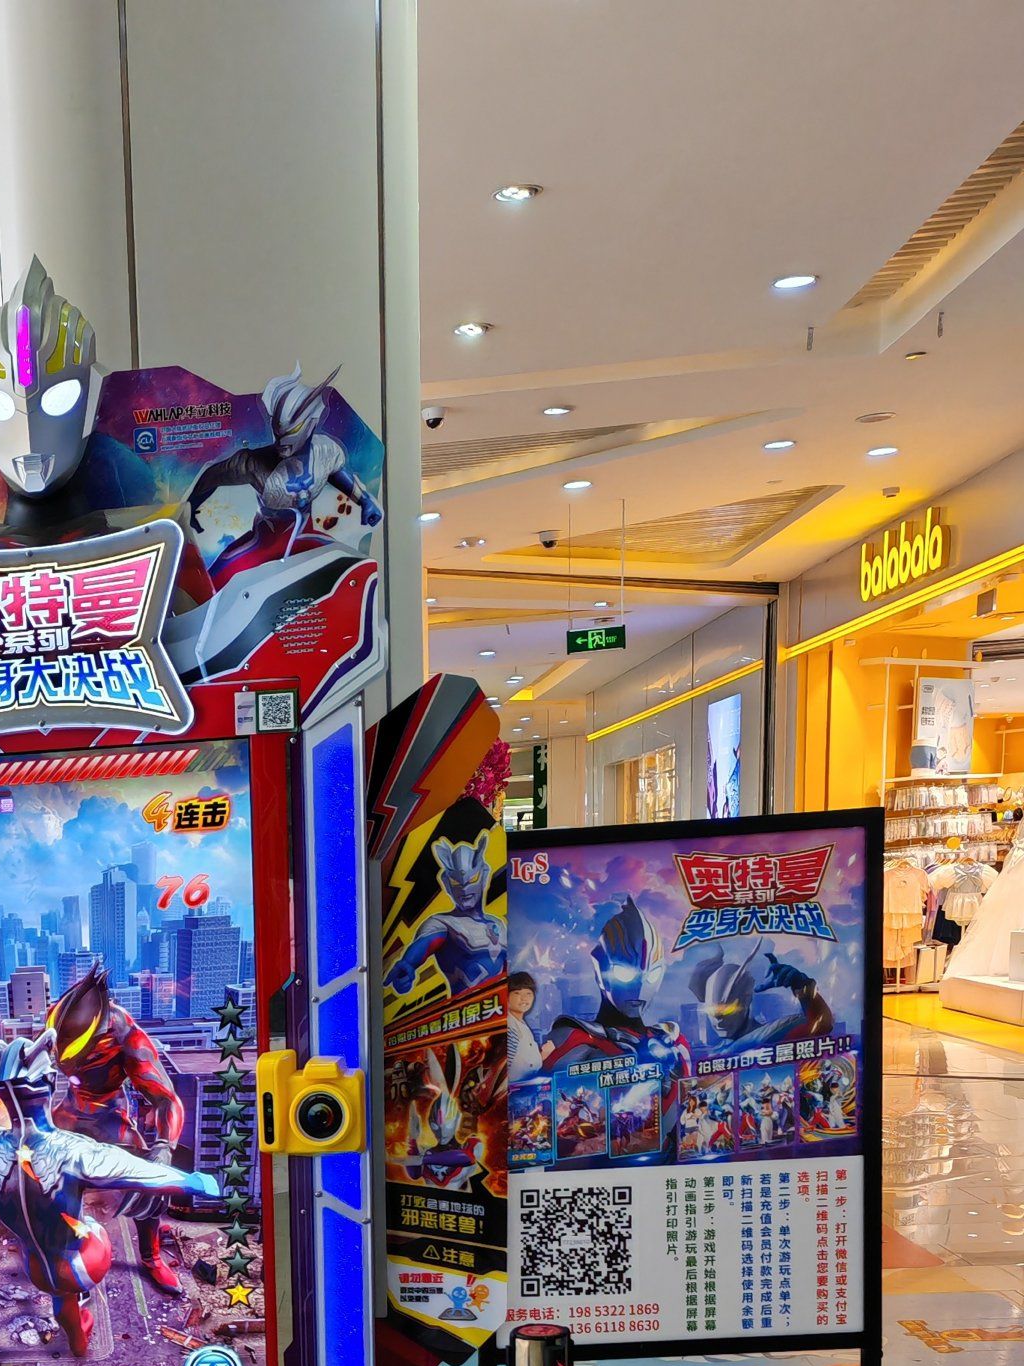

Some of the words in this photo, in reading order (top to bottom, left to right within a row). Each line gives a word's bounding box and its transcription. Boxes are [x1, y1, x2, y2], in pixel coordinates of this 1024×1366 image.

[185, 402, 232, 419] 华立科技
[860, 507, 943, 602] balabala
[3, 627, 69, 654] 系列
[175, 799, 229, 831] 连击
[511, 852, 549, 883] IGS
[683, 846, 833, 899] 奥特曼
[156, 874, 211, 909] 76
[734, 890, 775, 904] 系列
[678, 903, 835, 947] 变身大决战
[568, 1057, 636, 1076] 感受最真实的
[598, 1069, 663, 1088] 体感战斗
[400, 1194, 485, 1216] 打败危害地球的
[442, 1247, 475, 1268] 注意
[684, 1177, 698, 1332] 动画指引游玩最后根据屏幕
[741, 1175, 754, 1330] 新扫描二维码选择使用余额
[759, 1174, 772, 1329] 若是充值会员付款完成后重
[816, 1170, 828, 1325] 扫描二维码点击您要购买的
[569, 1307, 591, 1318] 198
[595, 1305, 625, 1317] 5322
[629, 1303, 660, 1315] 1869
[569, 1323, 591, 1334] 136
[595, 1321, 625, 1333] 6118
[629, 1320, 660, 1332] 8630
